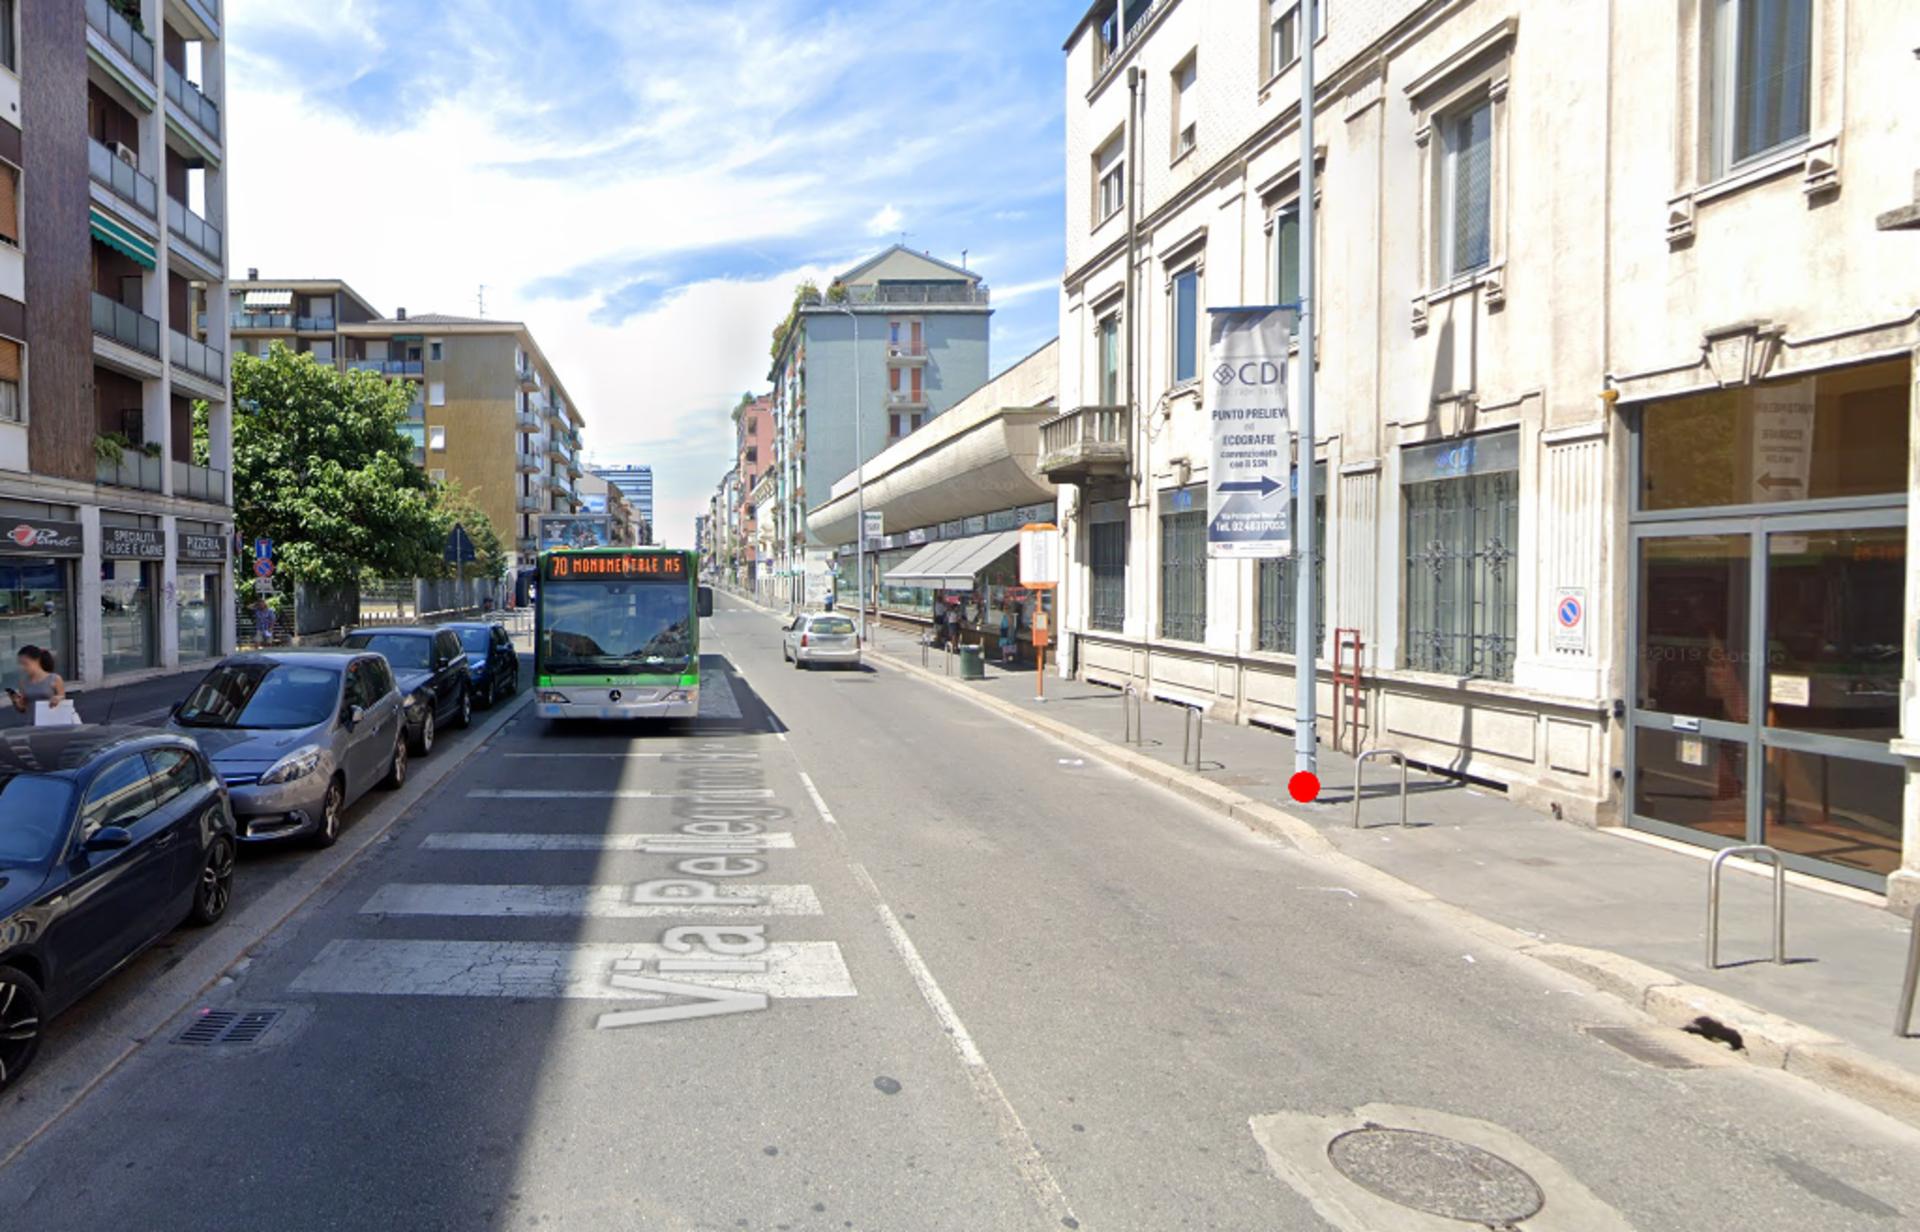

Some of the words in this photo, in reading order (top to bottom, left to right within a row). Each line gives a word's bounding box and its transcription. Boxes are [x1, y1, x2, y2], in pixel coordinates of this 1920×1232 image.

[1239, 362, 1285, 385] CDI
[1212, 409, 1244, 420] PUNTO
[1222, 435, 1276, 446] ECOGRAFIE
[187, 536, 220, 550] PIZZERIA
[552, 556, 568, 576] 70
